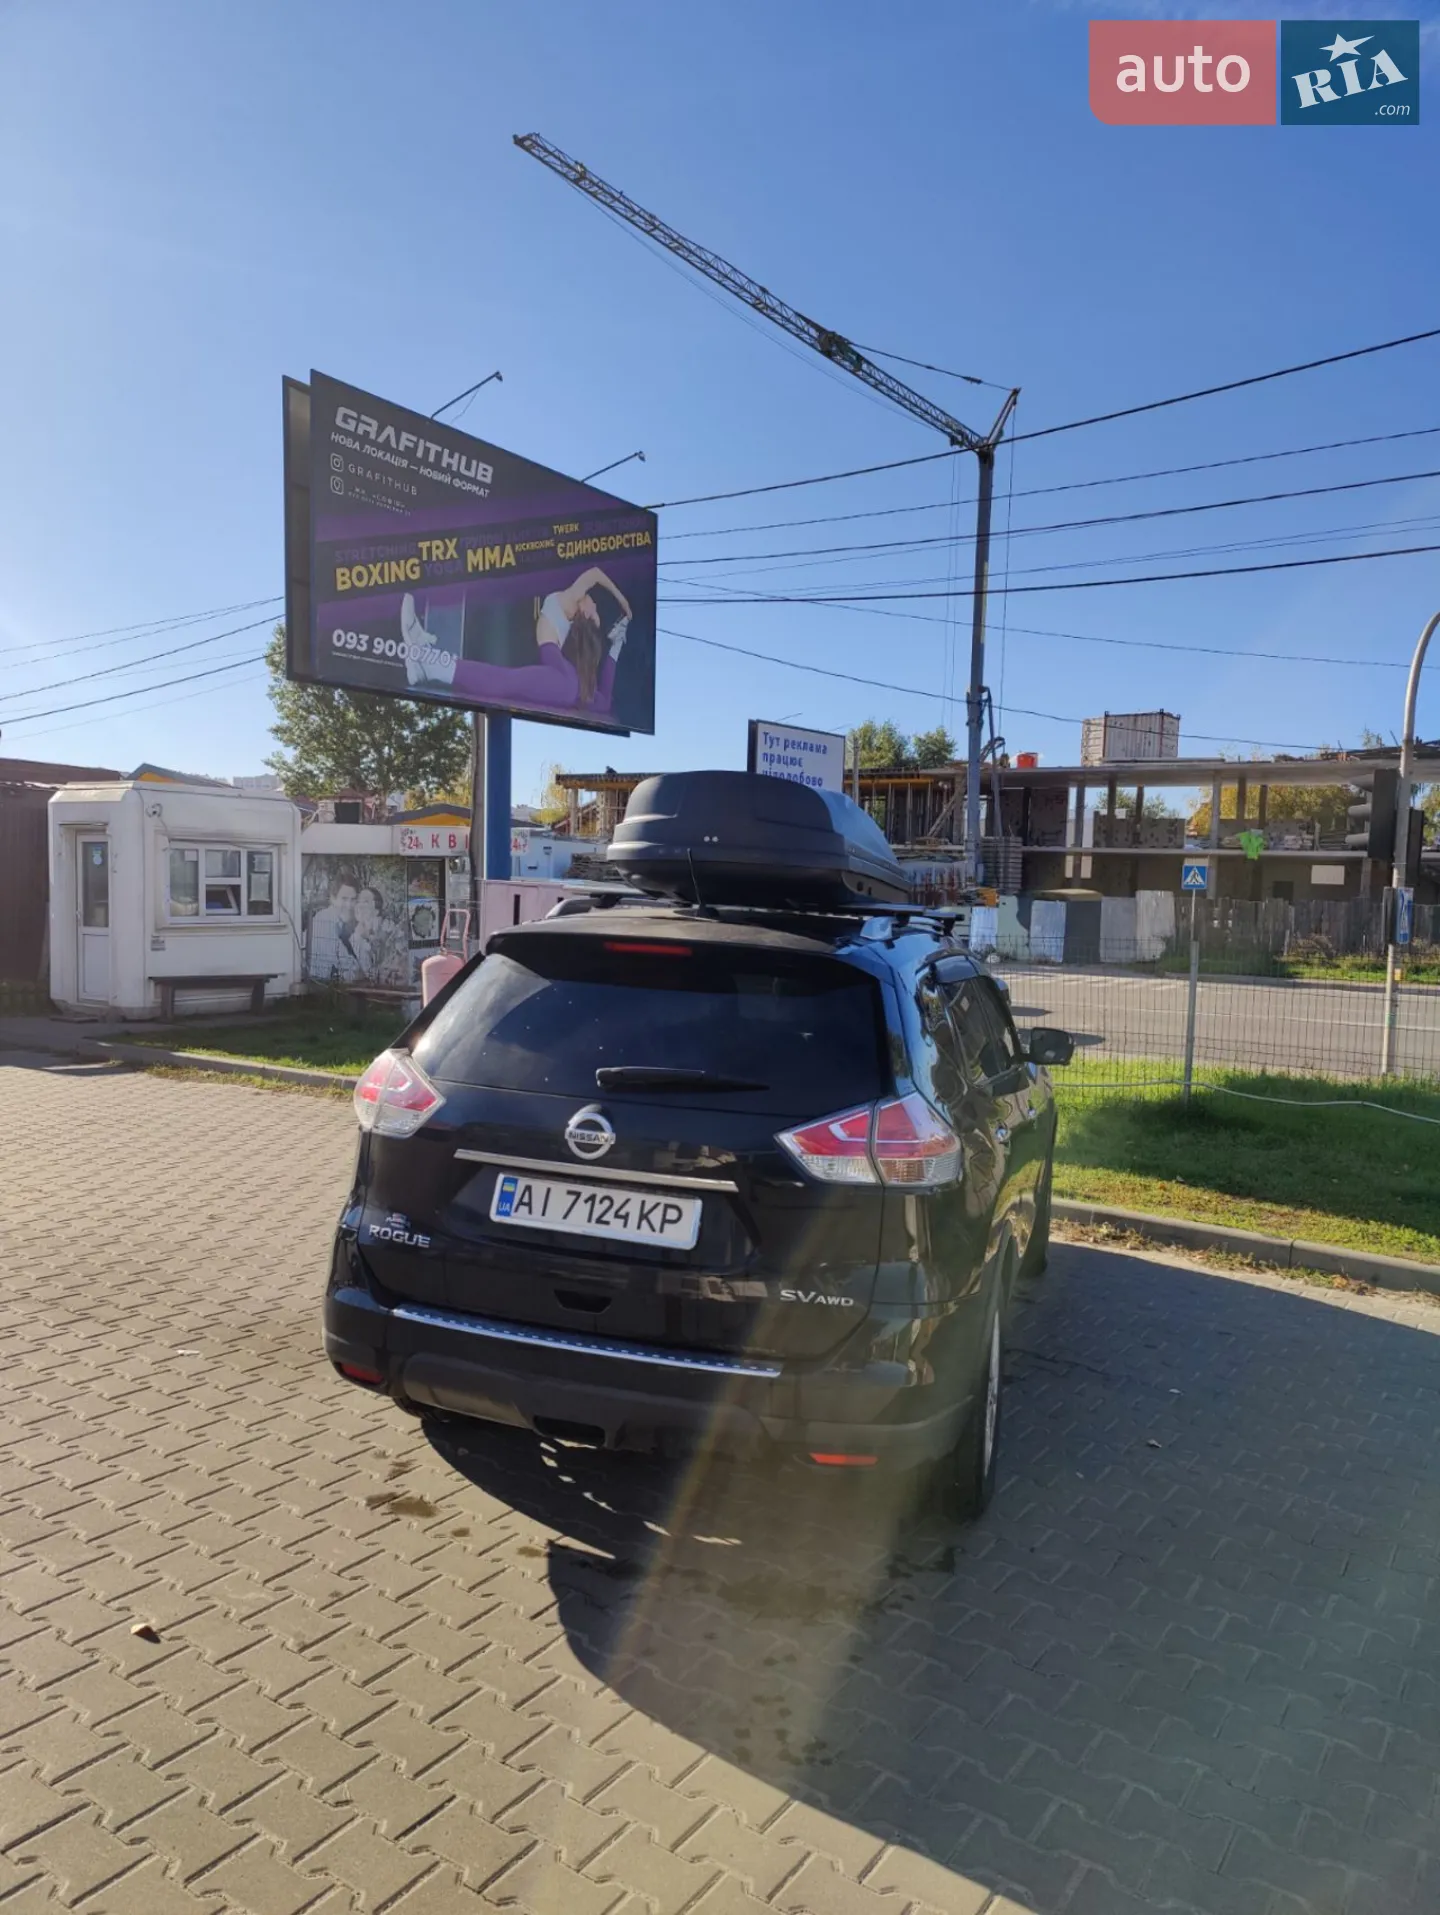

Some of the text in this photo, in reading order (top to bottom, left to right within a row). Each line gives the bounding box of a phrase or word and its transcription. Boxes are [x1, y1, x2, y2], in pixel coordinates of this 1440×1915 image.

[335, 406, 494, 484] GRAFITHUB
[330, 432, 360, 451] НОВА
[362, 444, 409, 468] ЛОКАЦІЯ
[419, 466, 450, 484] НОВИЙ
[452, 478, 490, 498] ФОРМАТ
[348, 463, 417, 495] GRAFITHUB
[552, 522, 580, 535] TWERK
[418, 537, 459, 562] TRX
[466, 544, 516, 573] MMA
[557, 531, 651, 560] ЄДИНОБОРСТВА
[335, 557, 421, 591] BOXING
[332, 629, 369, 652] 093
[763, 732, 828, 755] Тут реклама
[568, 1131, 609, 1143] NISSAN
[514, 1184, 551, 1217] AI
[562, 1190, 631, 1229] 7124
[636, 1199, 683, 1234] KP
[368, 1224, 431, 1248] ROGUE
